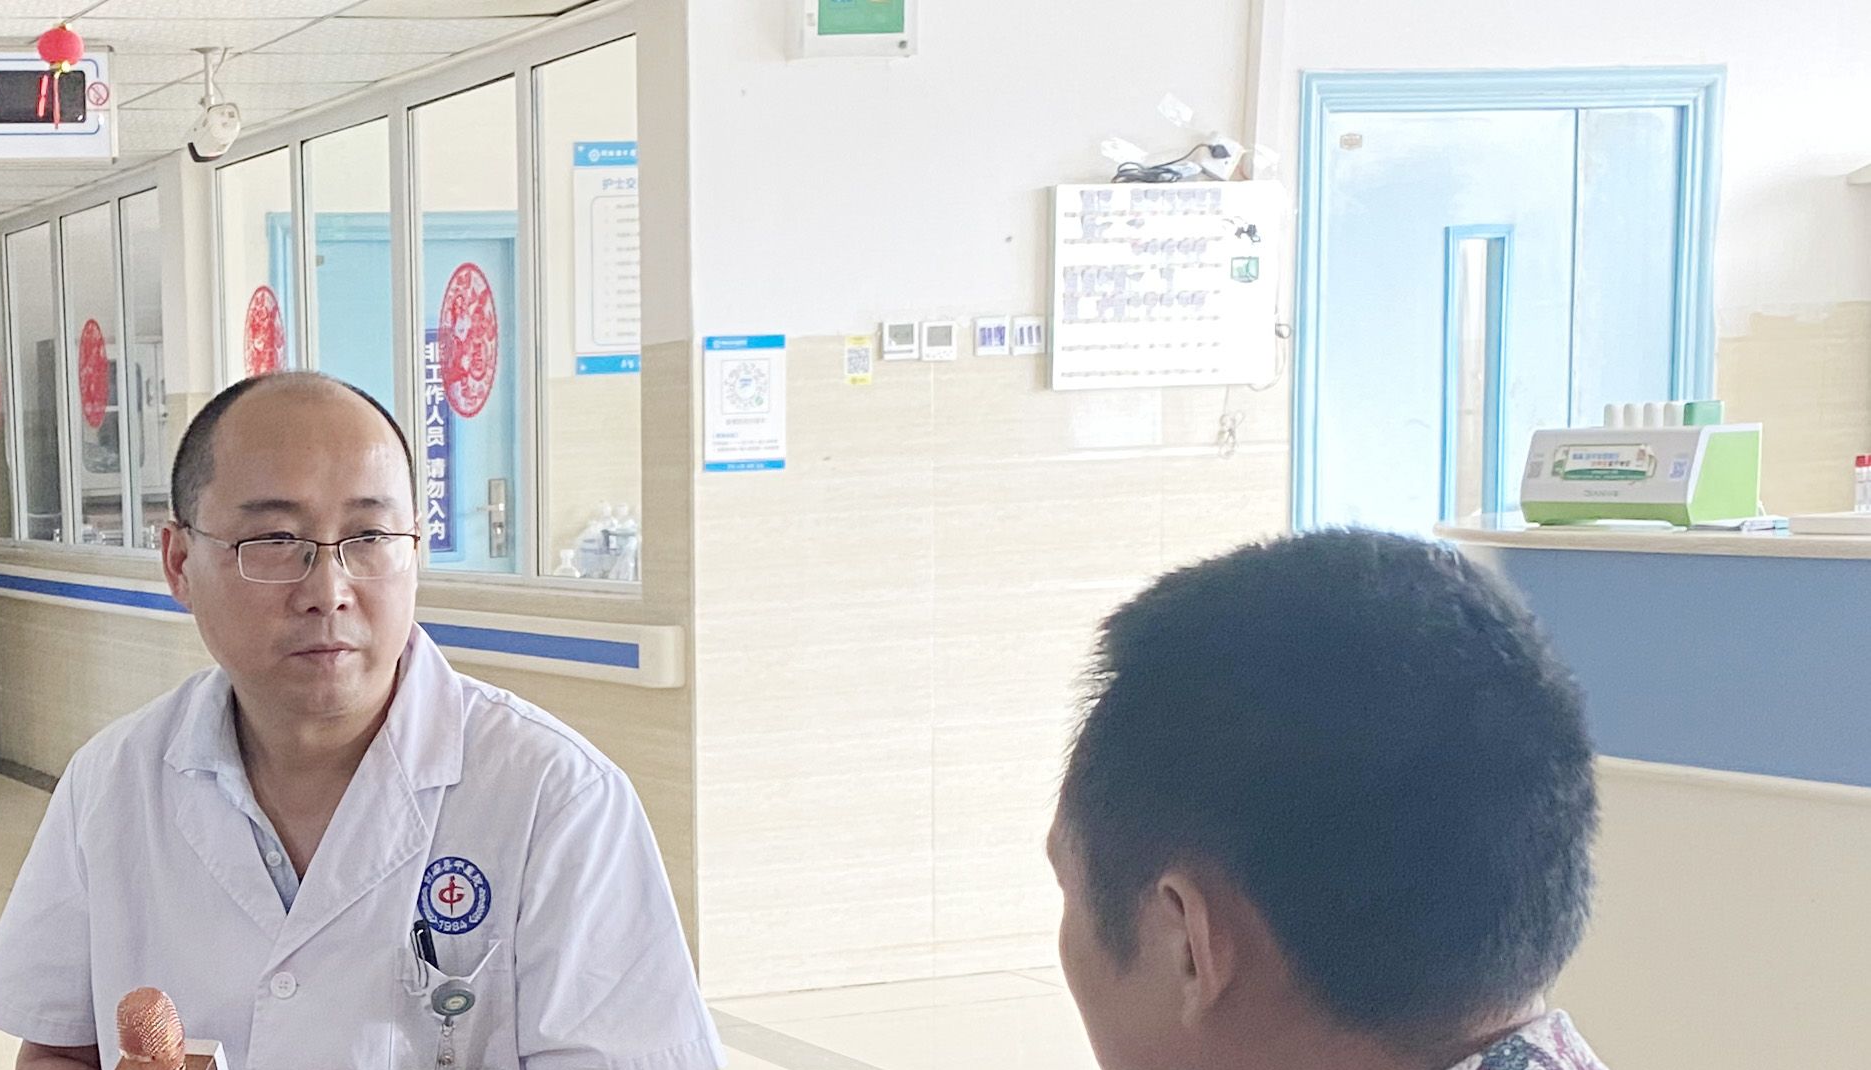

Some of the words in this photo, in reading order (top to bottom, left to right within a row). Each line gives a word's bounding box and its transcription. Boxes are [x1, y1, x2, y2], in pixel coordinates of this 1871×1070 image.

[426, 457, 446, 541] 请勿入内
[438, 920, 468, 932] 1984
